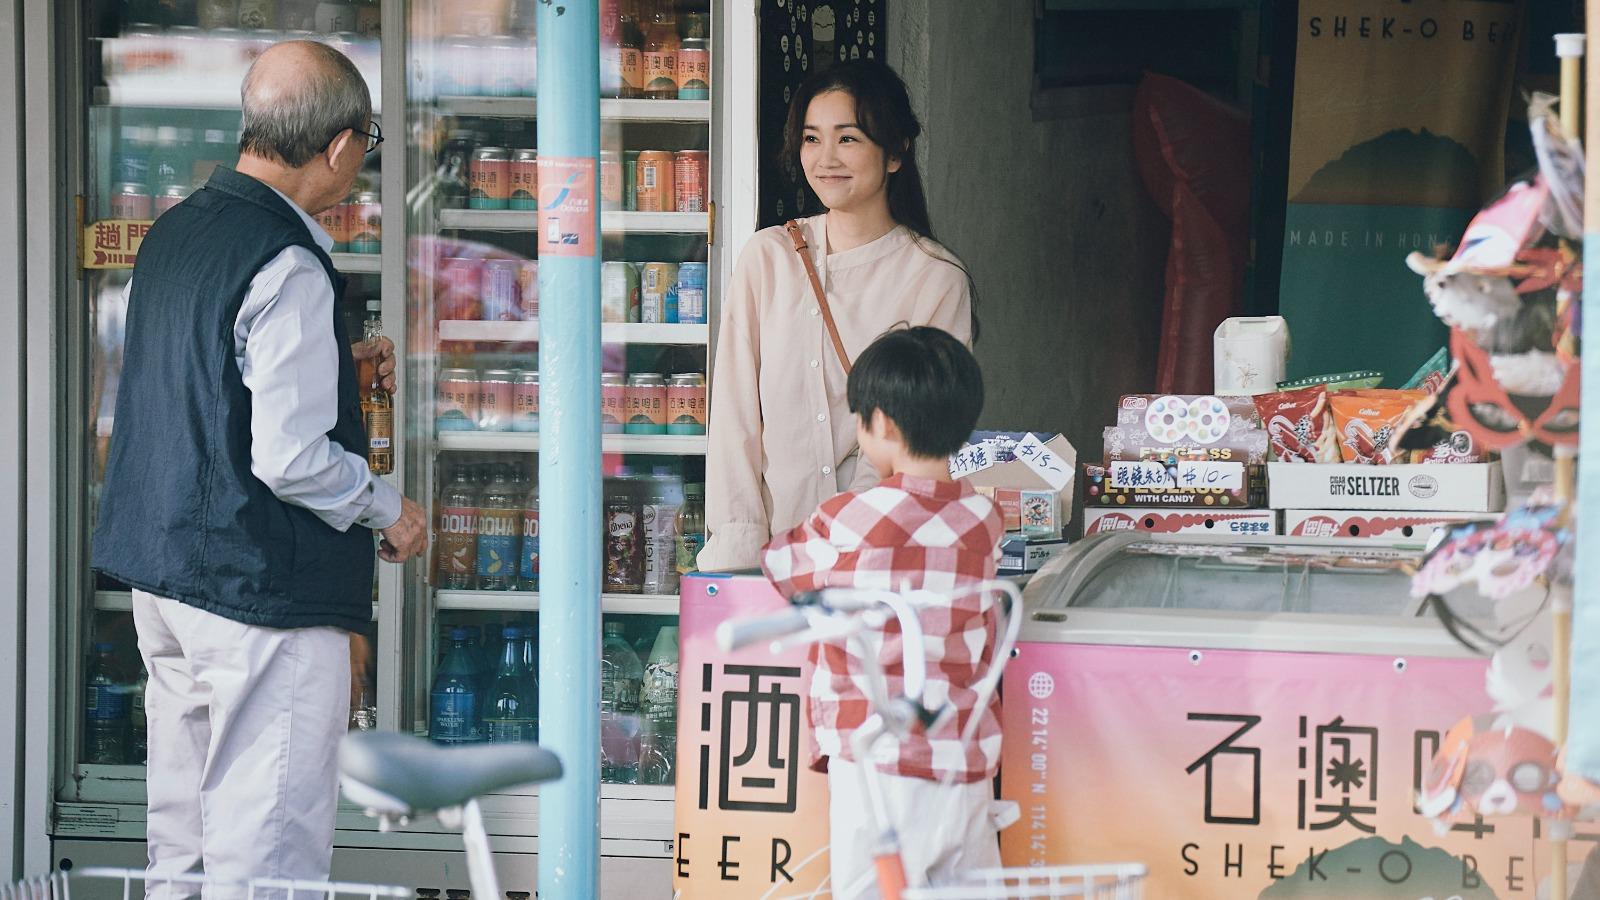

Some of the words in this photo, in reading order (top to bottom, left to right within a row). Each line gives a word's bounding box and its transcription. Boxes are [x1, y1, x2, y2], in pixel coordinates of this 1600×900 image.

[1310, 16, 1437, 38] SHEK-O
[1463, 20, 1516, 43] BE
[644, 56, 679, 69] 石澳啤
[680, 62, 710, 73] 石澳啤
[1290, 230, 1349, 247] MADE
[1365, 231, 1383, 248] IN
[518, 394, 539, 406] 石澳
[1330, 476, 1346, 484] CIGAR
[1347, 476, 1400, 496] SELTZER
[1134, 494, 1161, 503] WITH
[1162, 494, 1195, 503] CANDY
[1330, 485, 1346, 496] CITY
[441, 514, 478, 534] OOHA
[479, 516, 515, 536] OOHA
[523, 518, 539, 538] OO
[1031, 707, 1048, 725] 22
[699, 662, 801, 813] 酒
[1031, 784, 1047, 794] N
[1030, 805, 1047, 829] 114
[677, 833, 793, 882] EER
[1181, 843, 1412, 883] SHEK-O
